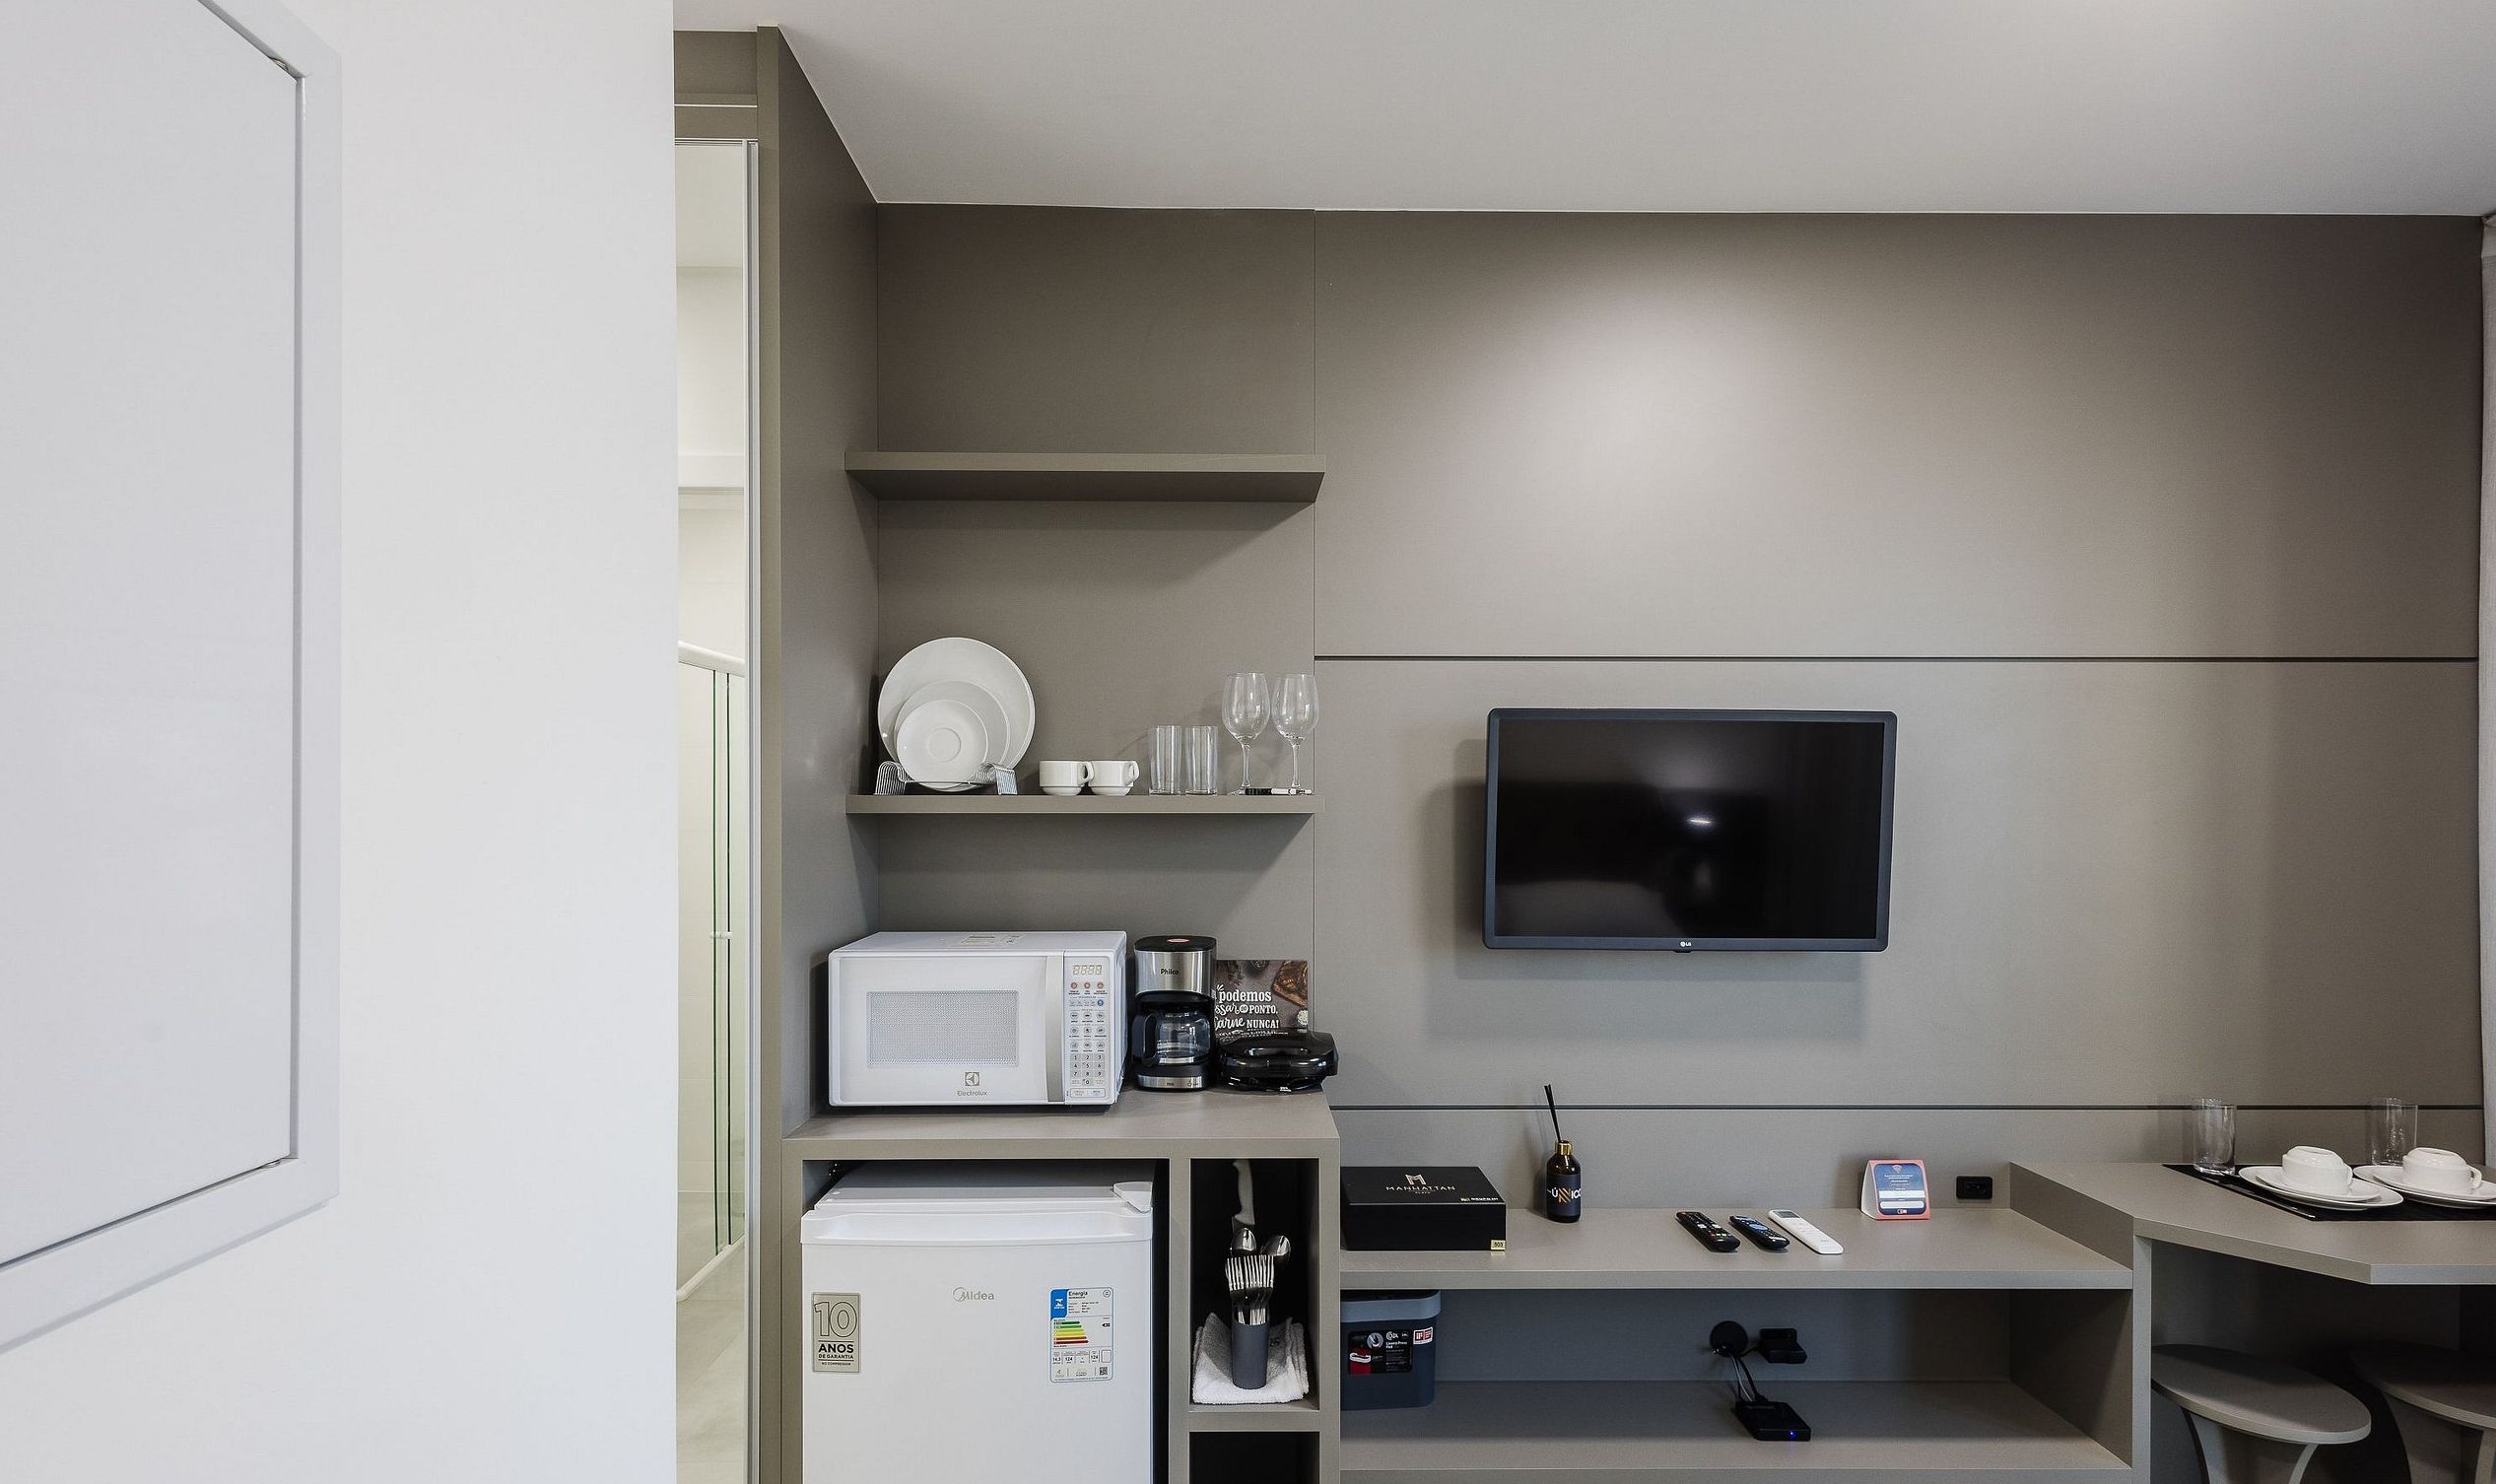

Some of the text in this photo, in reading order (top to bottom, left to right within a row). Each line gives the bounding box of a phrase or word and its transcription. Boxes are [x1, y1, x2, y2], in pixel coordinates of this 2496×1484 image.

[1219, 989, 1272, 1003] podemos
[1247, 1019, 1279, 1029] NUNCA!
[955, 1287, 994, 1301] Midea
[813, 1301, 858, 1338] 10
[818, 1343, 854, 1354] ANOS
